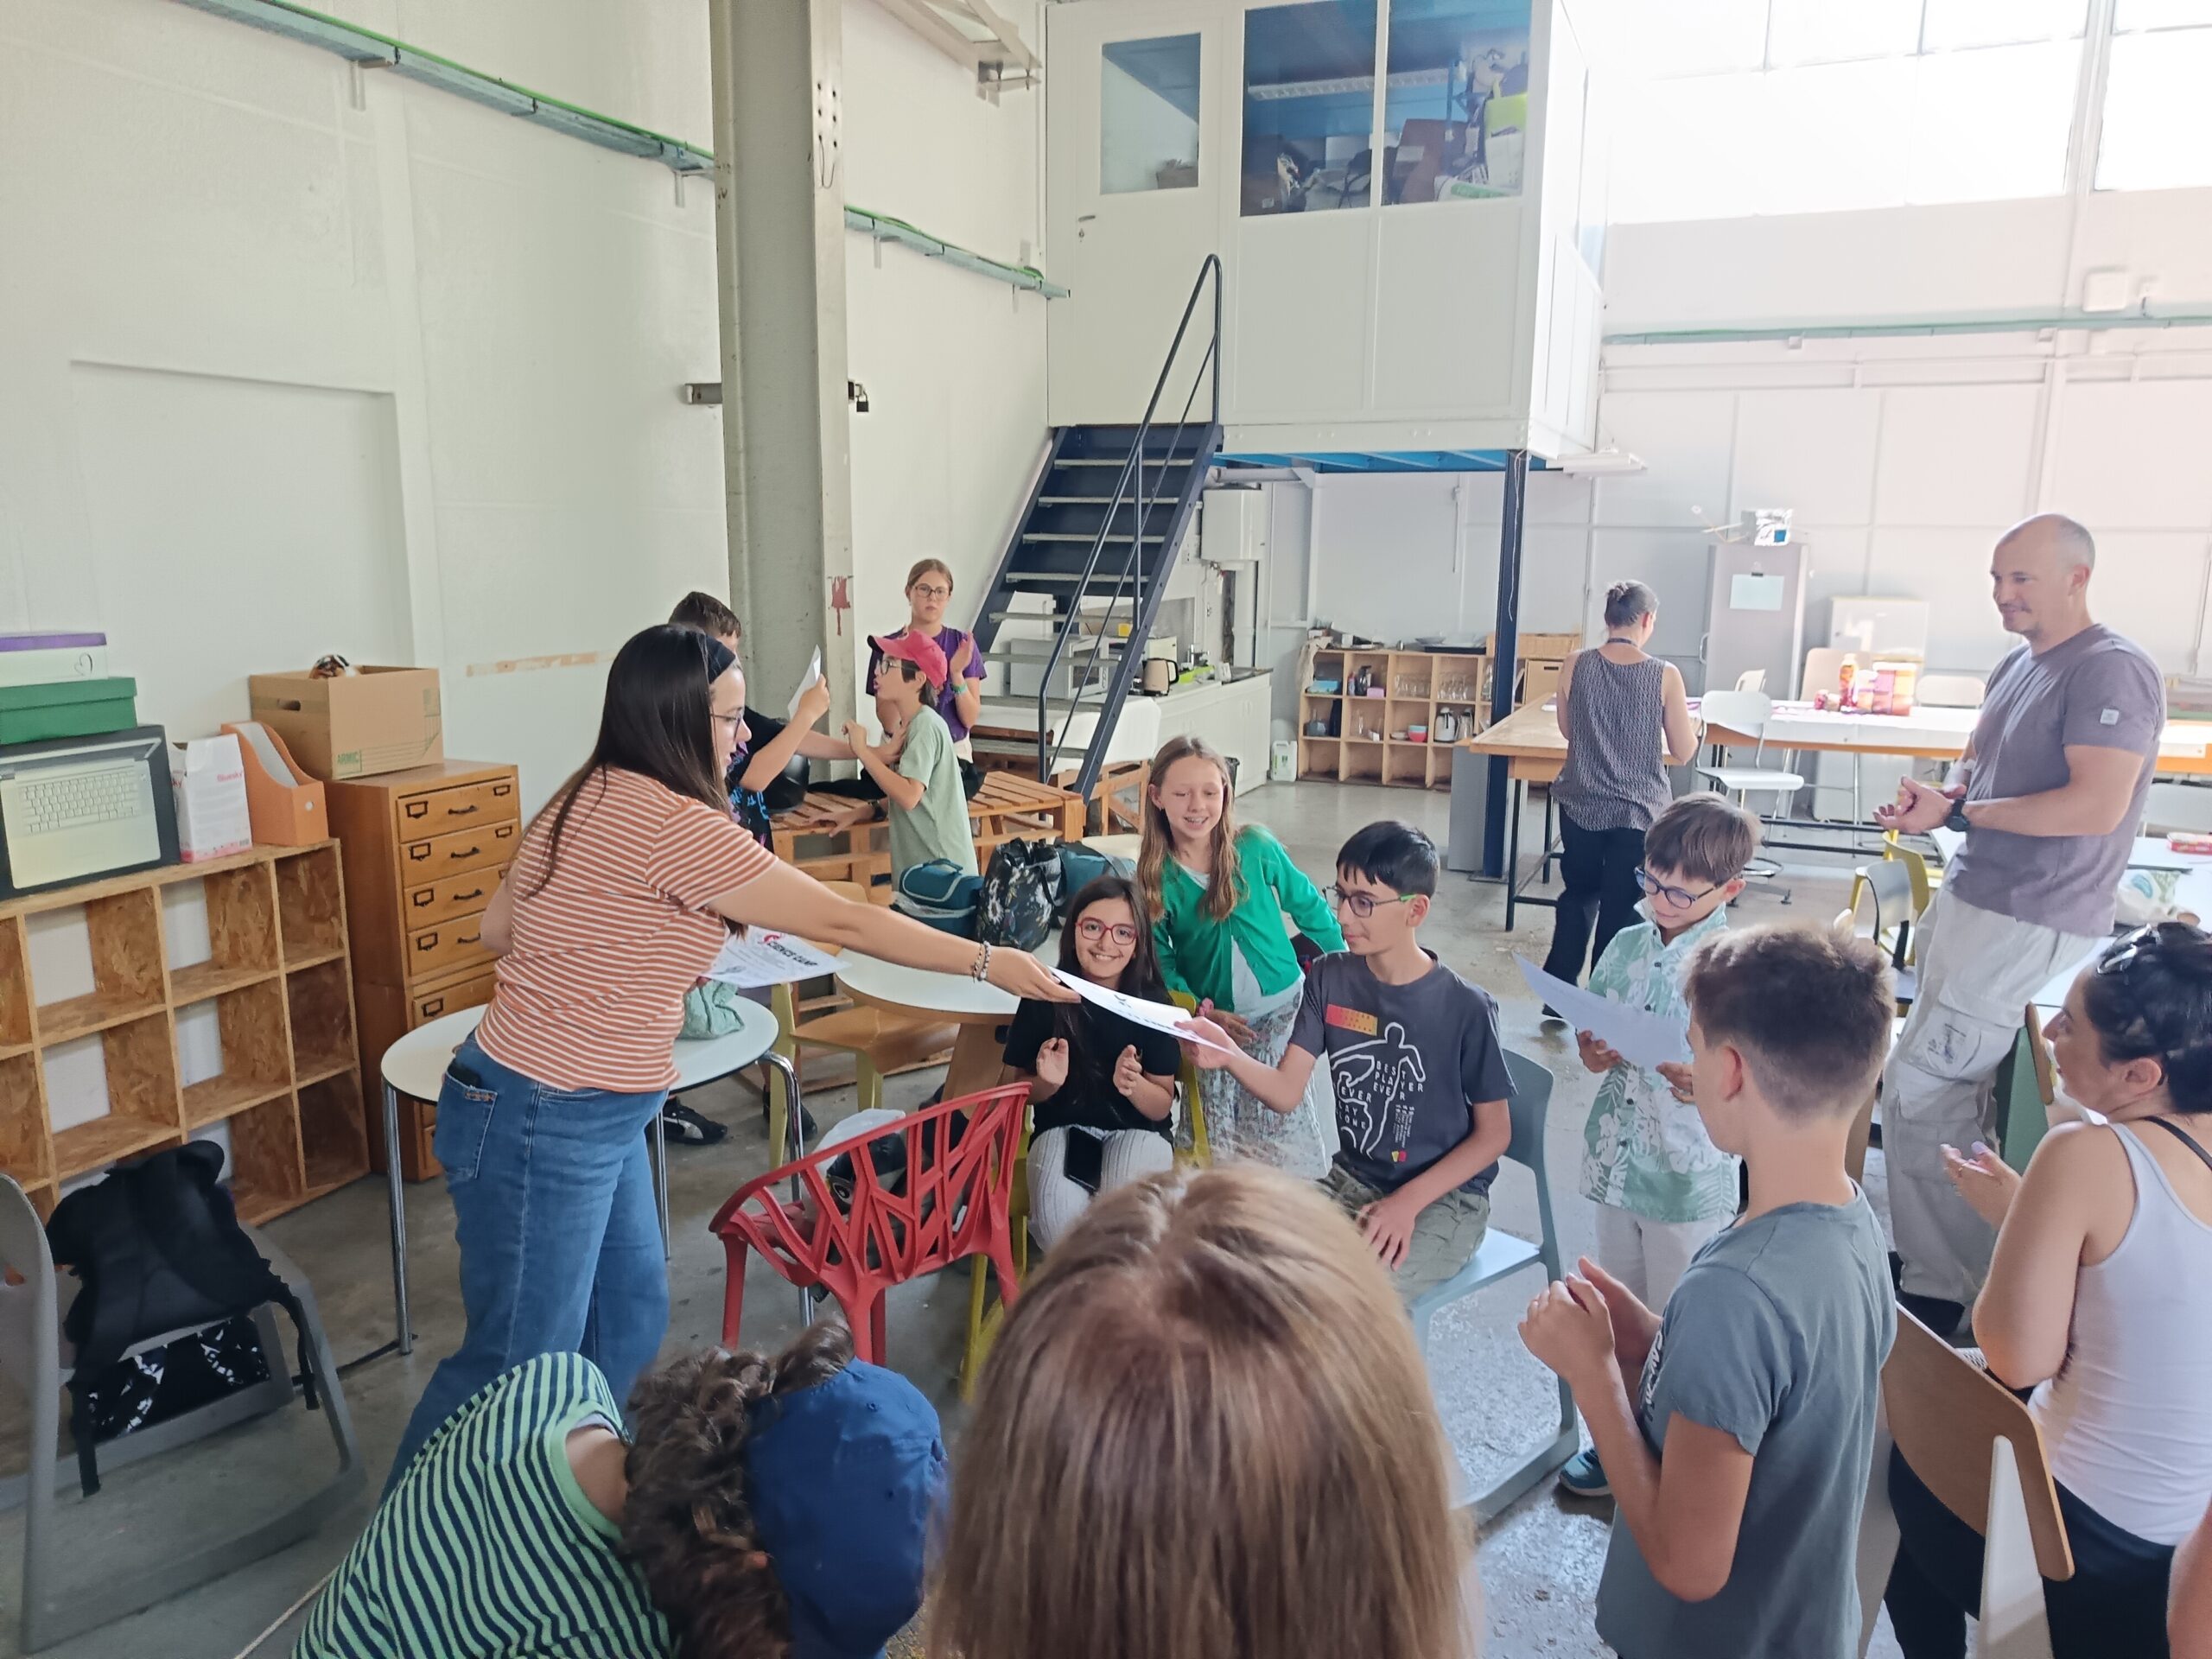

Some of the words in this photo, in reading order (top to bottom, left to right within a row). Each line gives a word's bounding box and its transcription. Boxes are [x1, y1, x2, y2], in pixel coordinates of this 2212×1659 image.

[1376, 1060, 1407, 1079] BEST
[1373, 1082, 1406, 1101] EVER
[1375, 1071, 1424, 1093] PLAYER
[1338, 1100, 1357, 1116] LAY
[1336, 1109, 1366, 1130] LONE
